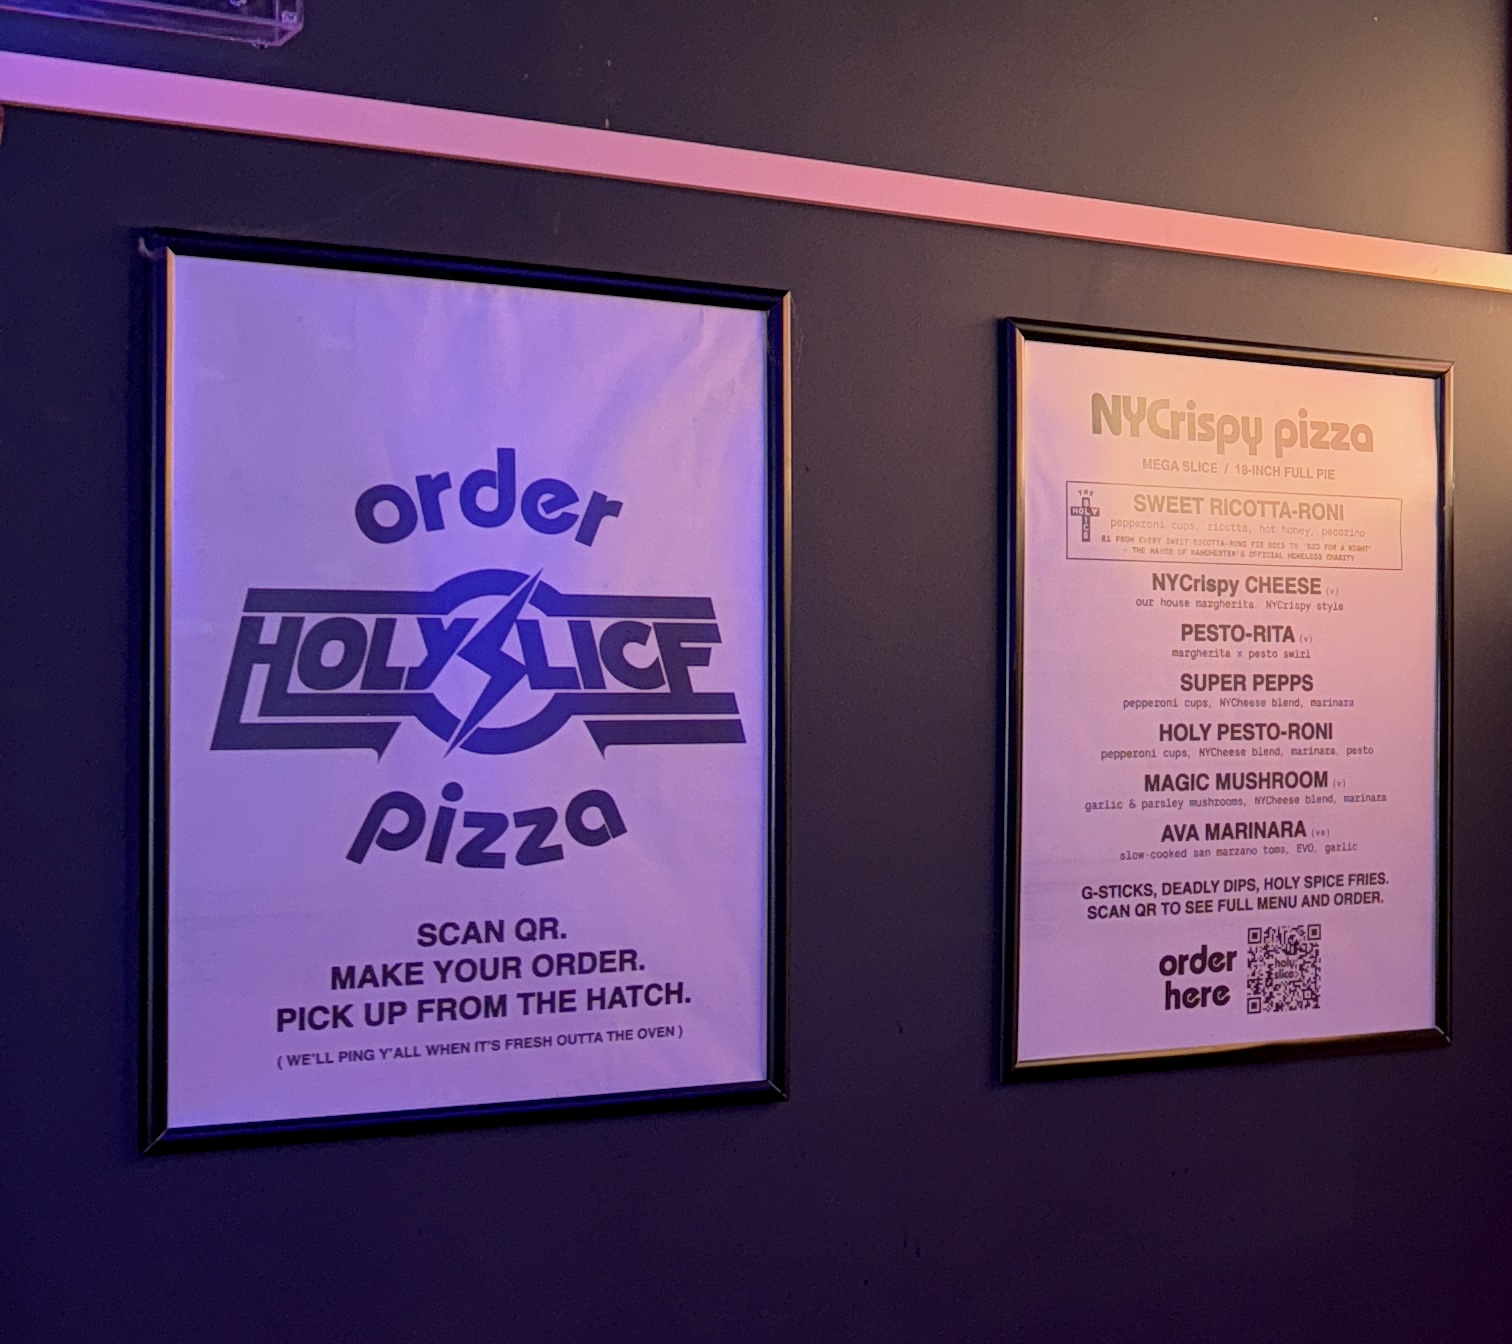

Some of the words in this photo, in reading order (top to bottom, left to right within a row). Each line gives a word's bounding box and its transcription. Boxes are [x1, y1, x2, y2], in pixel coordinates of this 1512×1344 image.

[1091, 392, 1263, 456] NYCrispy
[1274, 408, 1374, 458] pizza
[1142, 458, 1180, 472] MEGA
[1183, 460, 1218, 474] SLICE
[1284, 467, 1314, 479] FULL
[1316, 468, 1336, 480] PIE
[354, 447, 624, 547] order
[1134, 494, 1205, 515] SWEET
[1210, 498, 1345, 522] RICOTTA-RONI
[1110, 518, 1165, 530] pepperoni
[1259, 524, 1277, 534] hot
[1321, 527, 1366, 538] pecorino
[1151, 573, 1240, 597] NYCrispy
[1244, 575, 1322, 595] CHEESE
[1135, 598, 1154, 607] our
[1160, 597, 1190, 607] house
[1180, 624, 1296, 643] PESTO-RITA
[1248, 649, 1278, 660] pesto
[210, 613, 478, 756] HOLY
[1180, 673, 1247, 692] SUPER
[1252, 674, 1314, 692] PEPPS
[1123, 698, 1178, 710] pepperoni
[1159, 723, 1212, 742] HOLY
[1217, 722, 1333, 741] PESTO-RONI
[1101, 748, 1158, 761] pepperoni
[1346, 745, 1374, 757] pesto
[1144, 773, 1210, 792] MAGIC
[1215, 771, 1329, 790] MUSHROOM
[1084, 799, 1123, 813] garlic
[1128, 799, 1137, 809] &
[1141, 798, 1184, 811] parsley
[345, 781, 628, 869] pizza
[1160, 824, 1200, 843] AVA
[1205, 820, 1308, 841] MARINARA
[1325, 842, 1358, 854] garlic
[1082, 884, 1158, 901] G-STICKS,
[1162, 880, 1220, 896] DEADLY
[1224, 878, 1260, 894] DIPS,
[1264, 876, 1300, 891] HOLY
[1304, 874, 1344, 889] SPICE
[1348, 872, 1390, 887] FRIES.
[1087, 904, 1131, 920] SCAN
[1135, 903, 1157, 918] QR
[1161, 901, 1181, 916] TO
[1185, 899, 1213, 914] SEE
[1217, 897, 1254, 913] FULL
[1257, 895, 1298, 911] MENU
[1301, 893, 1330, 908] AND
[1333, 891, 1384, 906] ORDER.
[416, 919, 505, 948] SCAN
[514, 917, 567, 942] QR.
[330, 961, 425, 991] MAKE
[432, 955, 522, 984] YOUR
[531, 949, 646, 978] ORDER.
[1159, 944, 1238, 977] order
[276, 1003, 355, 1033] PICK
[363, 1000, 408, 1027] UP
[416, 993, 508, 1023] FROM
[516, 989, 577, 1016] THE
[586, 982, 692, 1012] HATCH.
[1164, 980, 1231, 1011] here
[286, 1052, 335, 1067] WE'LL
[338, 1049, 375, 1063] PING
[378, 1045, 422, 1060] Y'ALL
[425, 1042, 471, 1056] WHEN
[474, 1040, 501, 1053] IT'S
[504, 1036, 553, 1050] FRESH
[556, 1032, 604, 1046] OUTTA
[606, 1029, 634, 1042] THE
[637, 1026, 675, 1040] OVEN
